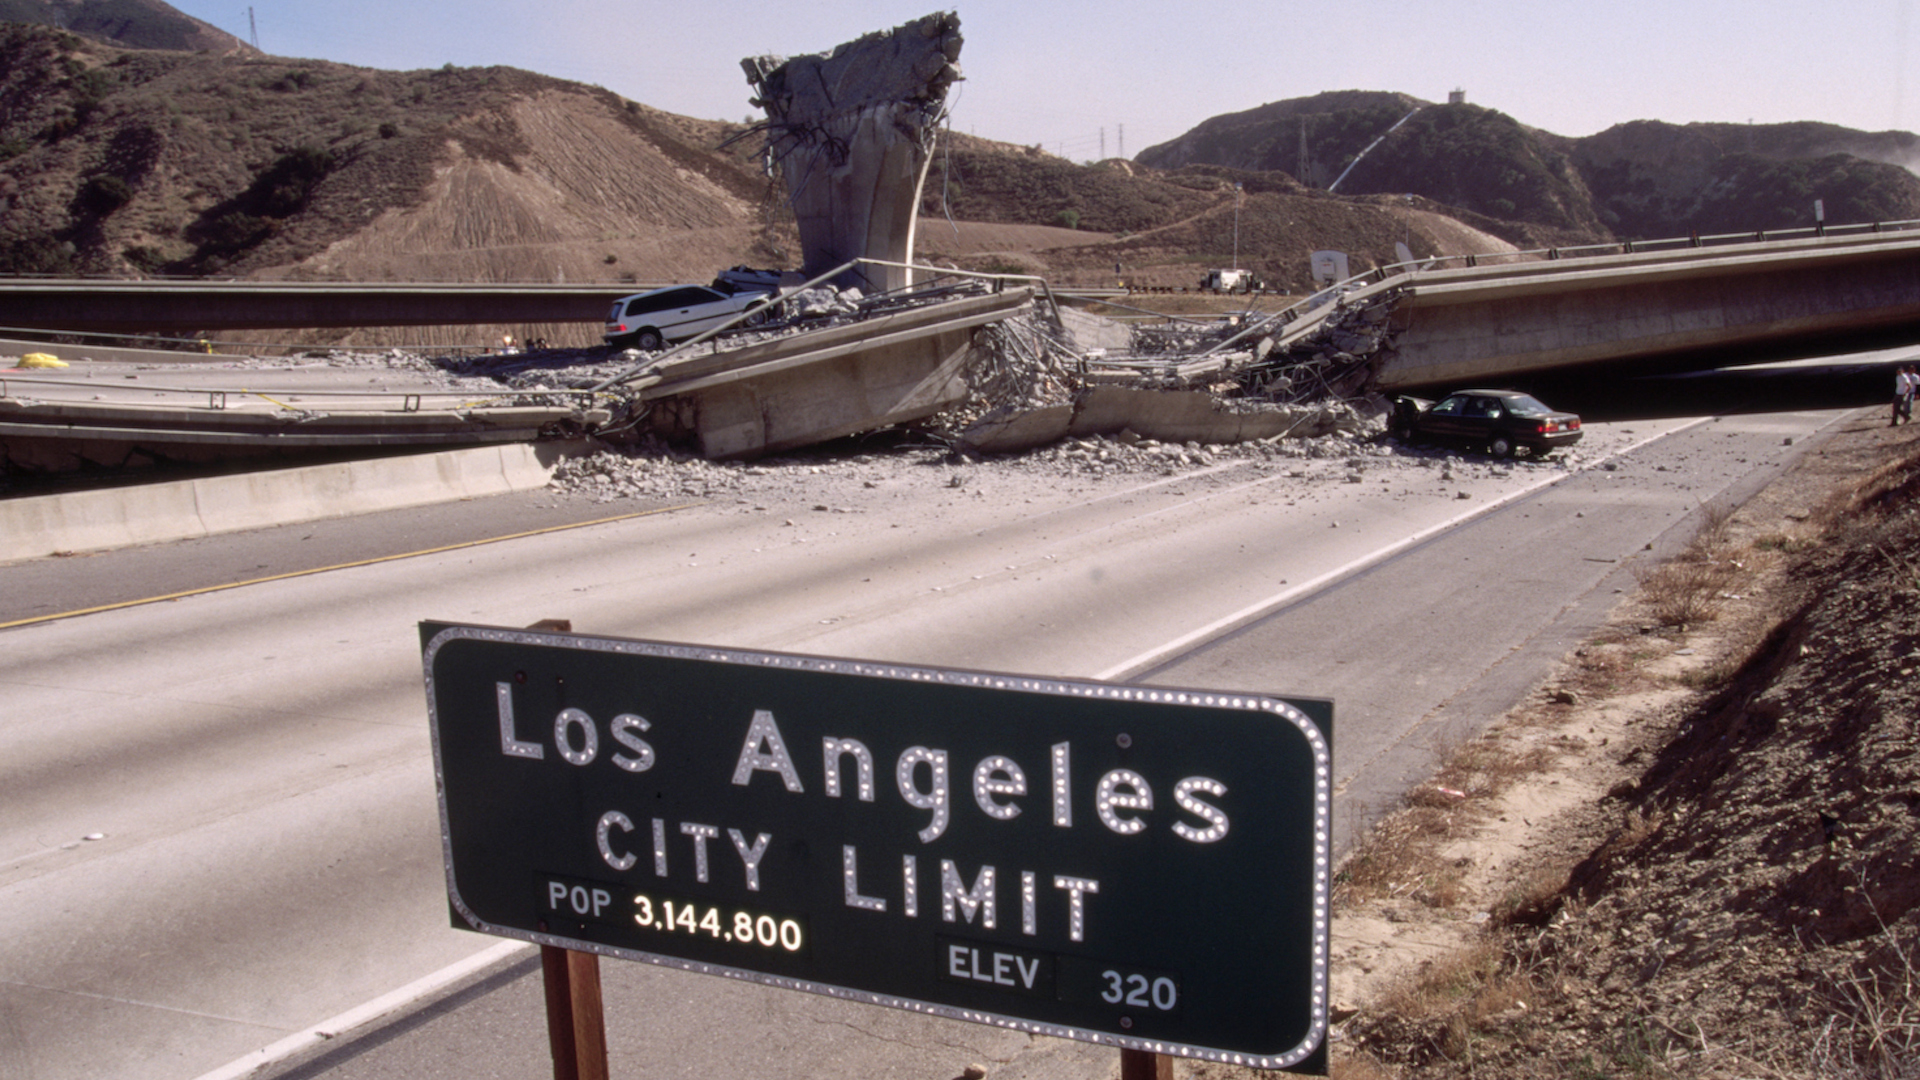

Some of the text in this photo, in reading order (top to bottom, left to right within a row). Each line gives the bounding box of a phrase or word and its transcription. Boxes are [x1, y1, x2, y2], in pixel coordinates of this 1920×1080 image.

[494, 681, 1231, 844] Los Angeles
[547, 880, 804, 953] POP 3,144,800
[596, 810, 1101, 942] CITY LIMIT
[948, 944, 1178, 1012] ELEV 320
